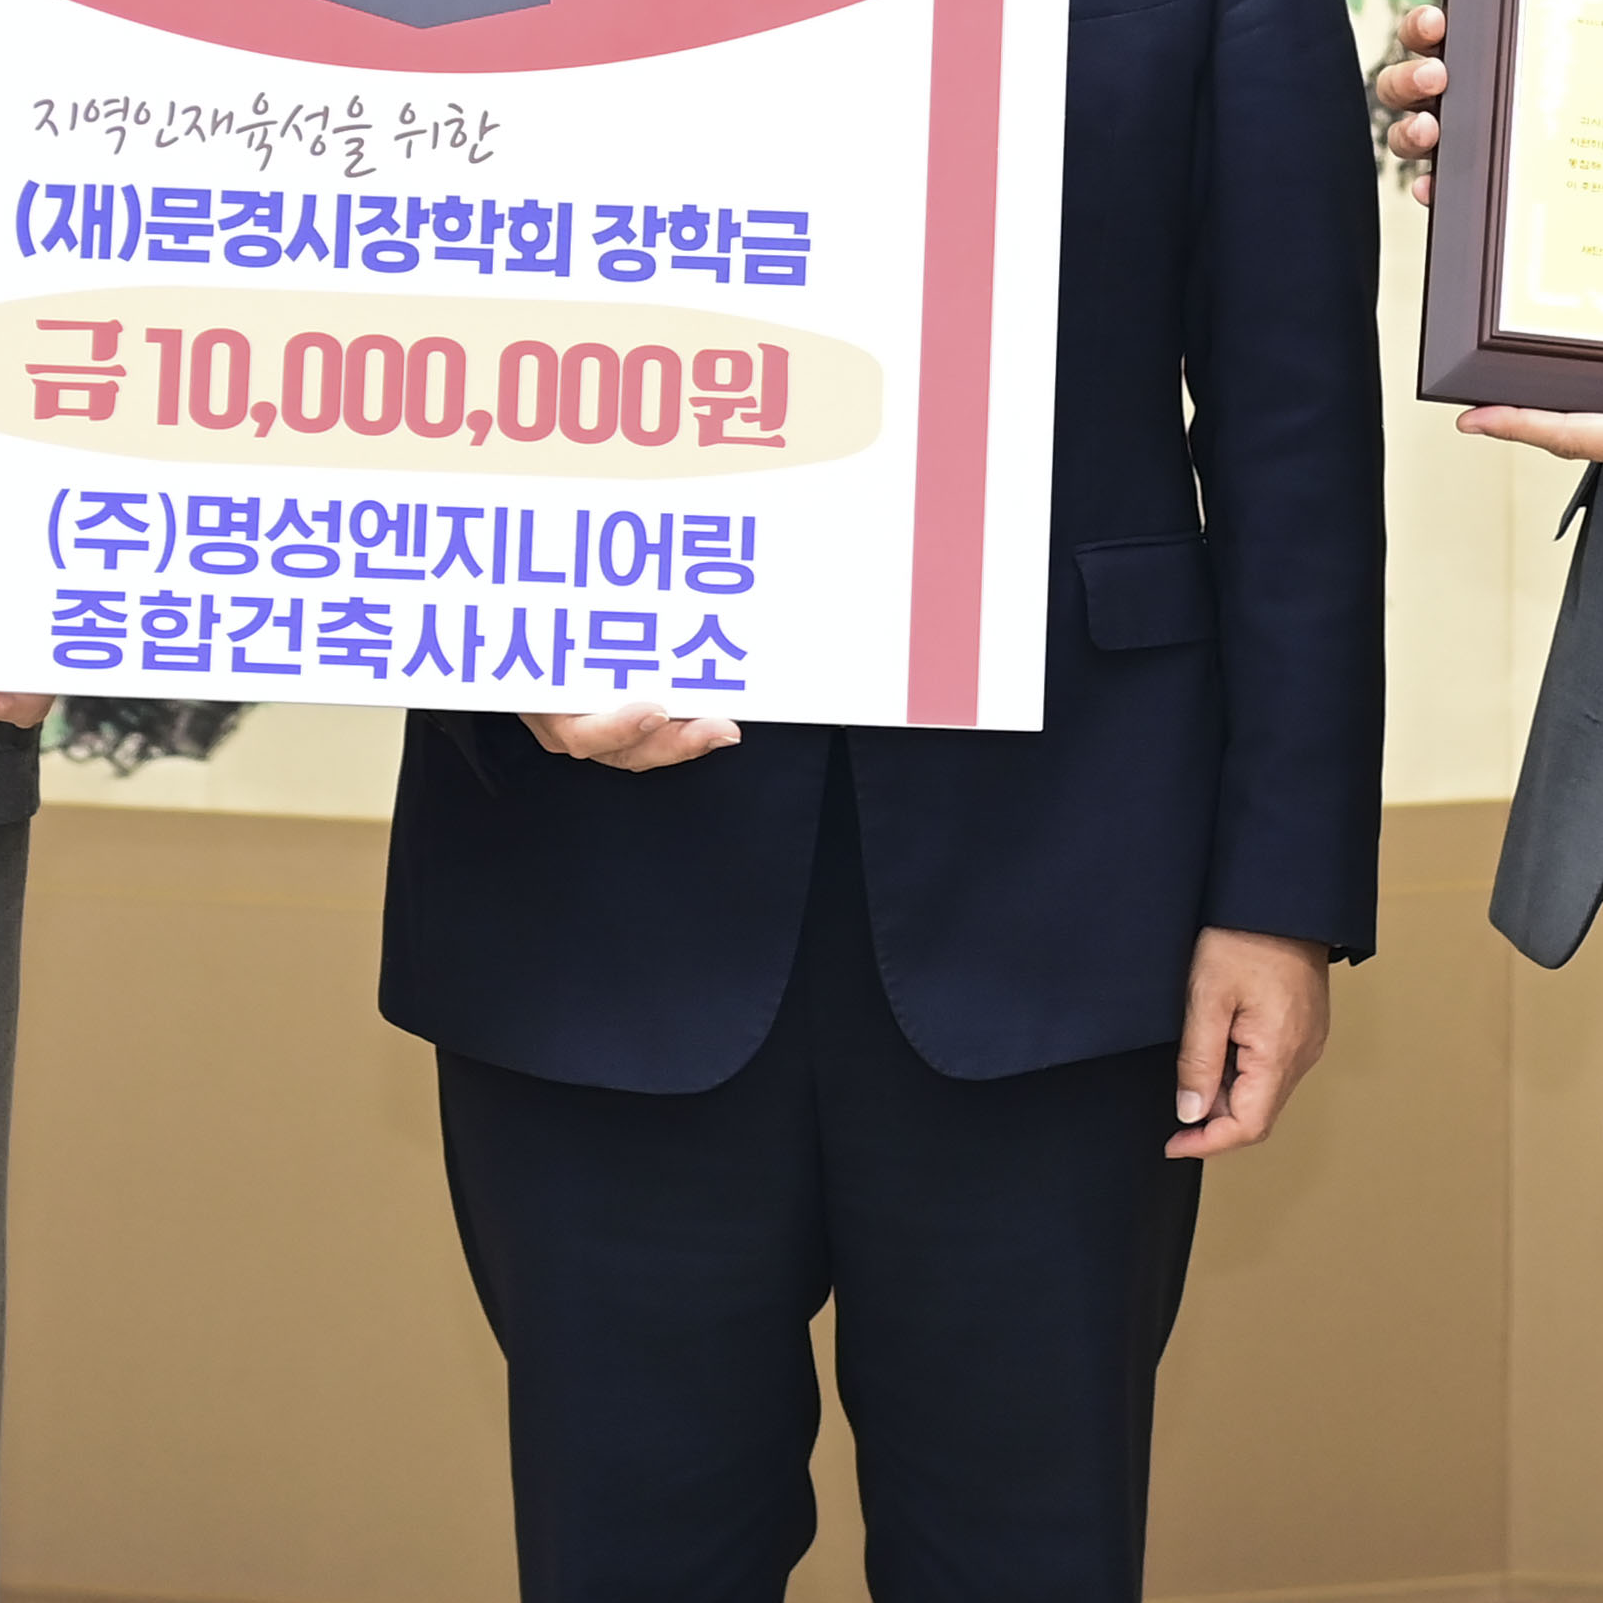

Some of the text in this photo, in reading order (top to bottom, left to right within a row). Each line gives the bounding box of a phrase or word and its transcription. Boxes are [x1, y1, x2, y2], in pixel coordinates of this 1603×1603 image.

[33, 91, 501, 179] 지역인재육성을 위한
[15, 180, 811, 287] (재)문경시장학회 장학금
[48, 488, 756, 595] (주)명성엔지니어링
[51, 588, 747, 691] 종합건축사사무소
